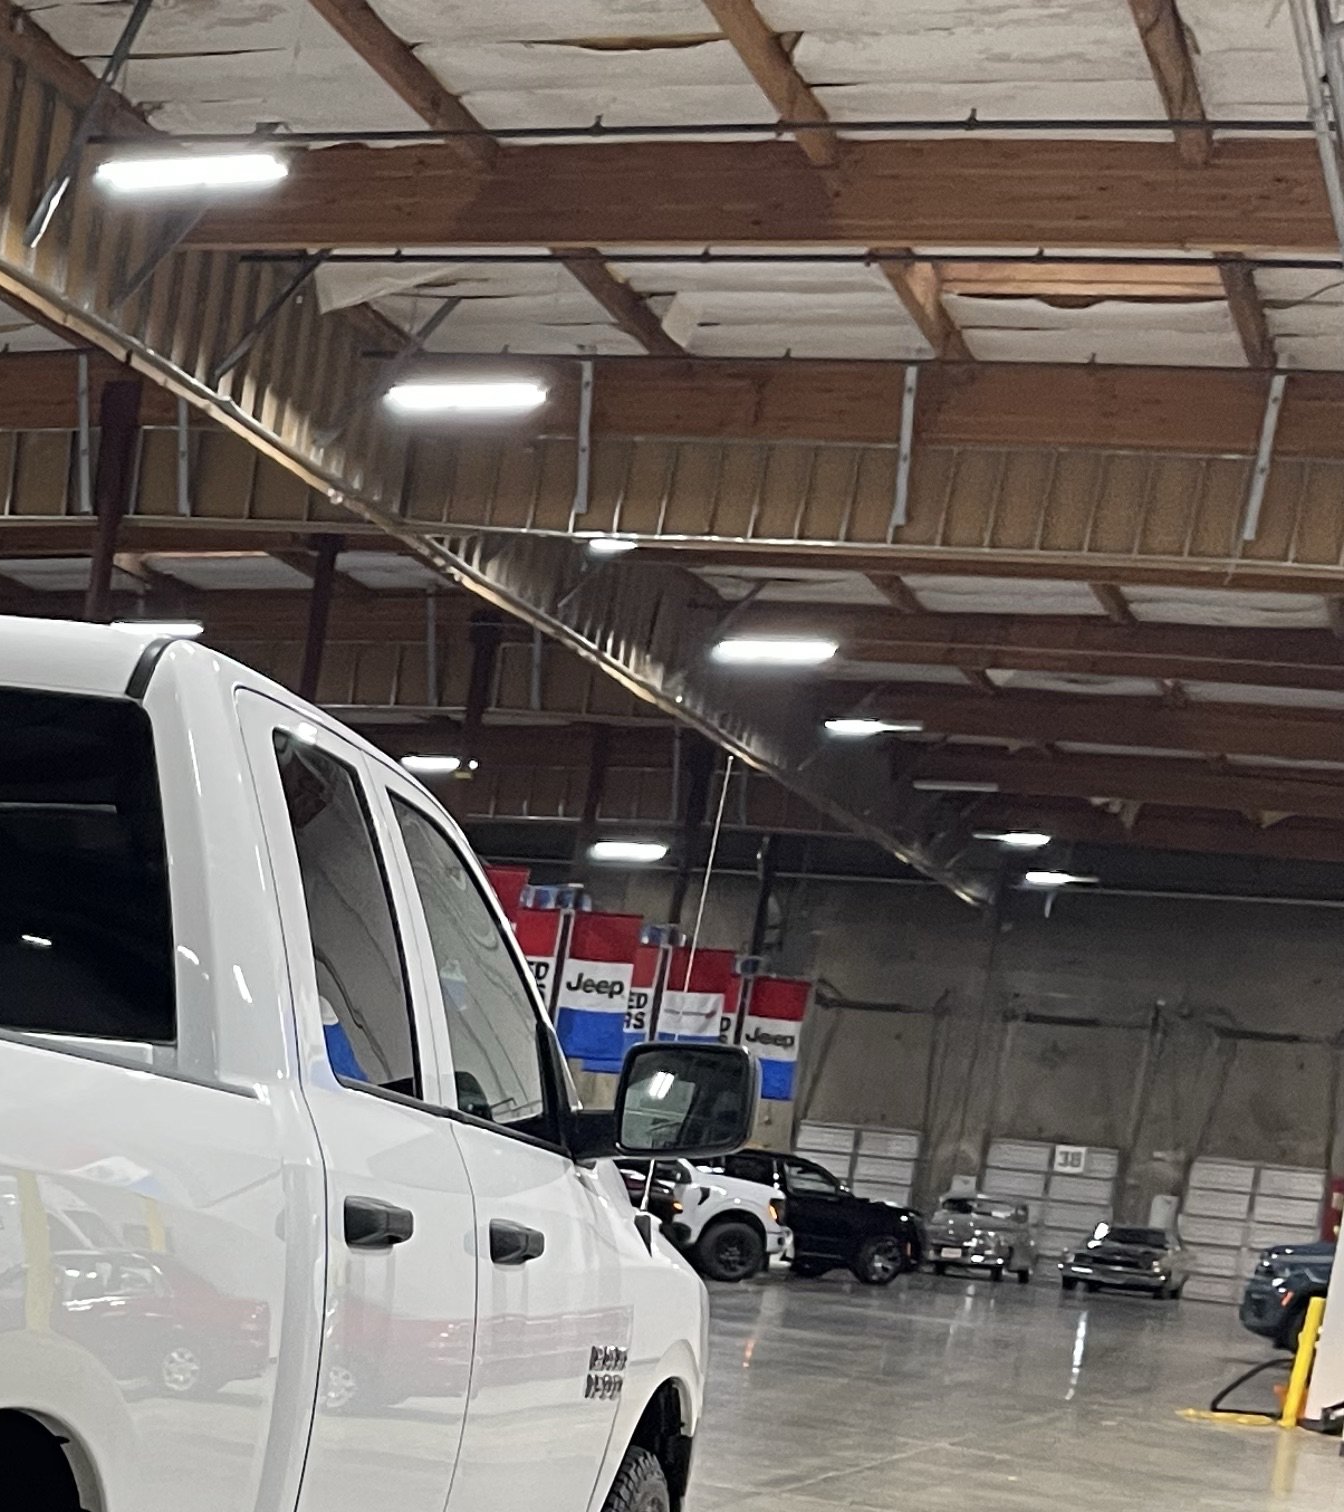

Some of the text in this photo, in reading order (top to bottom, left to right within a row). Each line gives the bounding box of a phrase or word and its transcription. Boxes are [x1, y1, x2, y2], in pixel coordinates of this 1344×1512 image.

[566, 972, 624, 999] Jeep
[628, 991, 649, 1010] ED
[745, 1027, 795, 1048] Jeep
